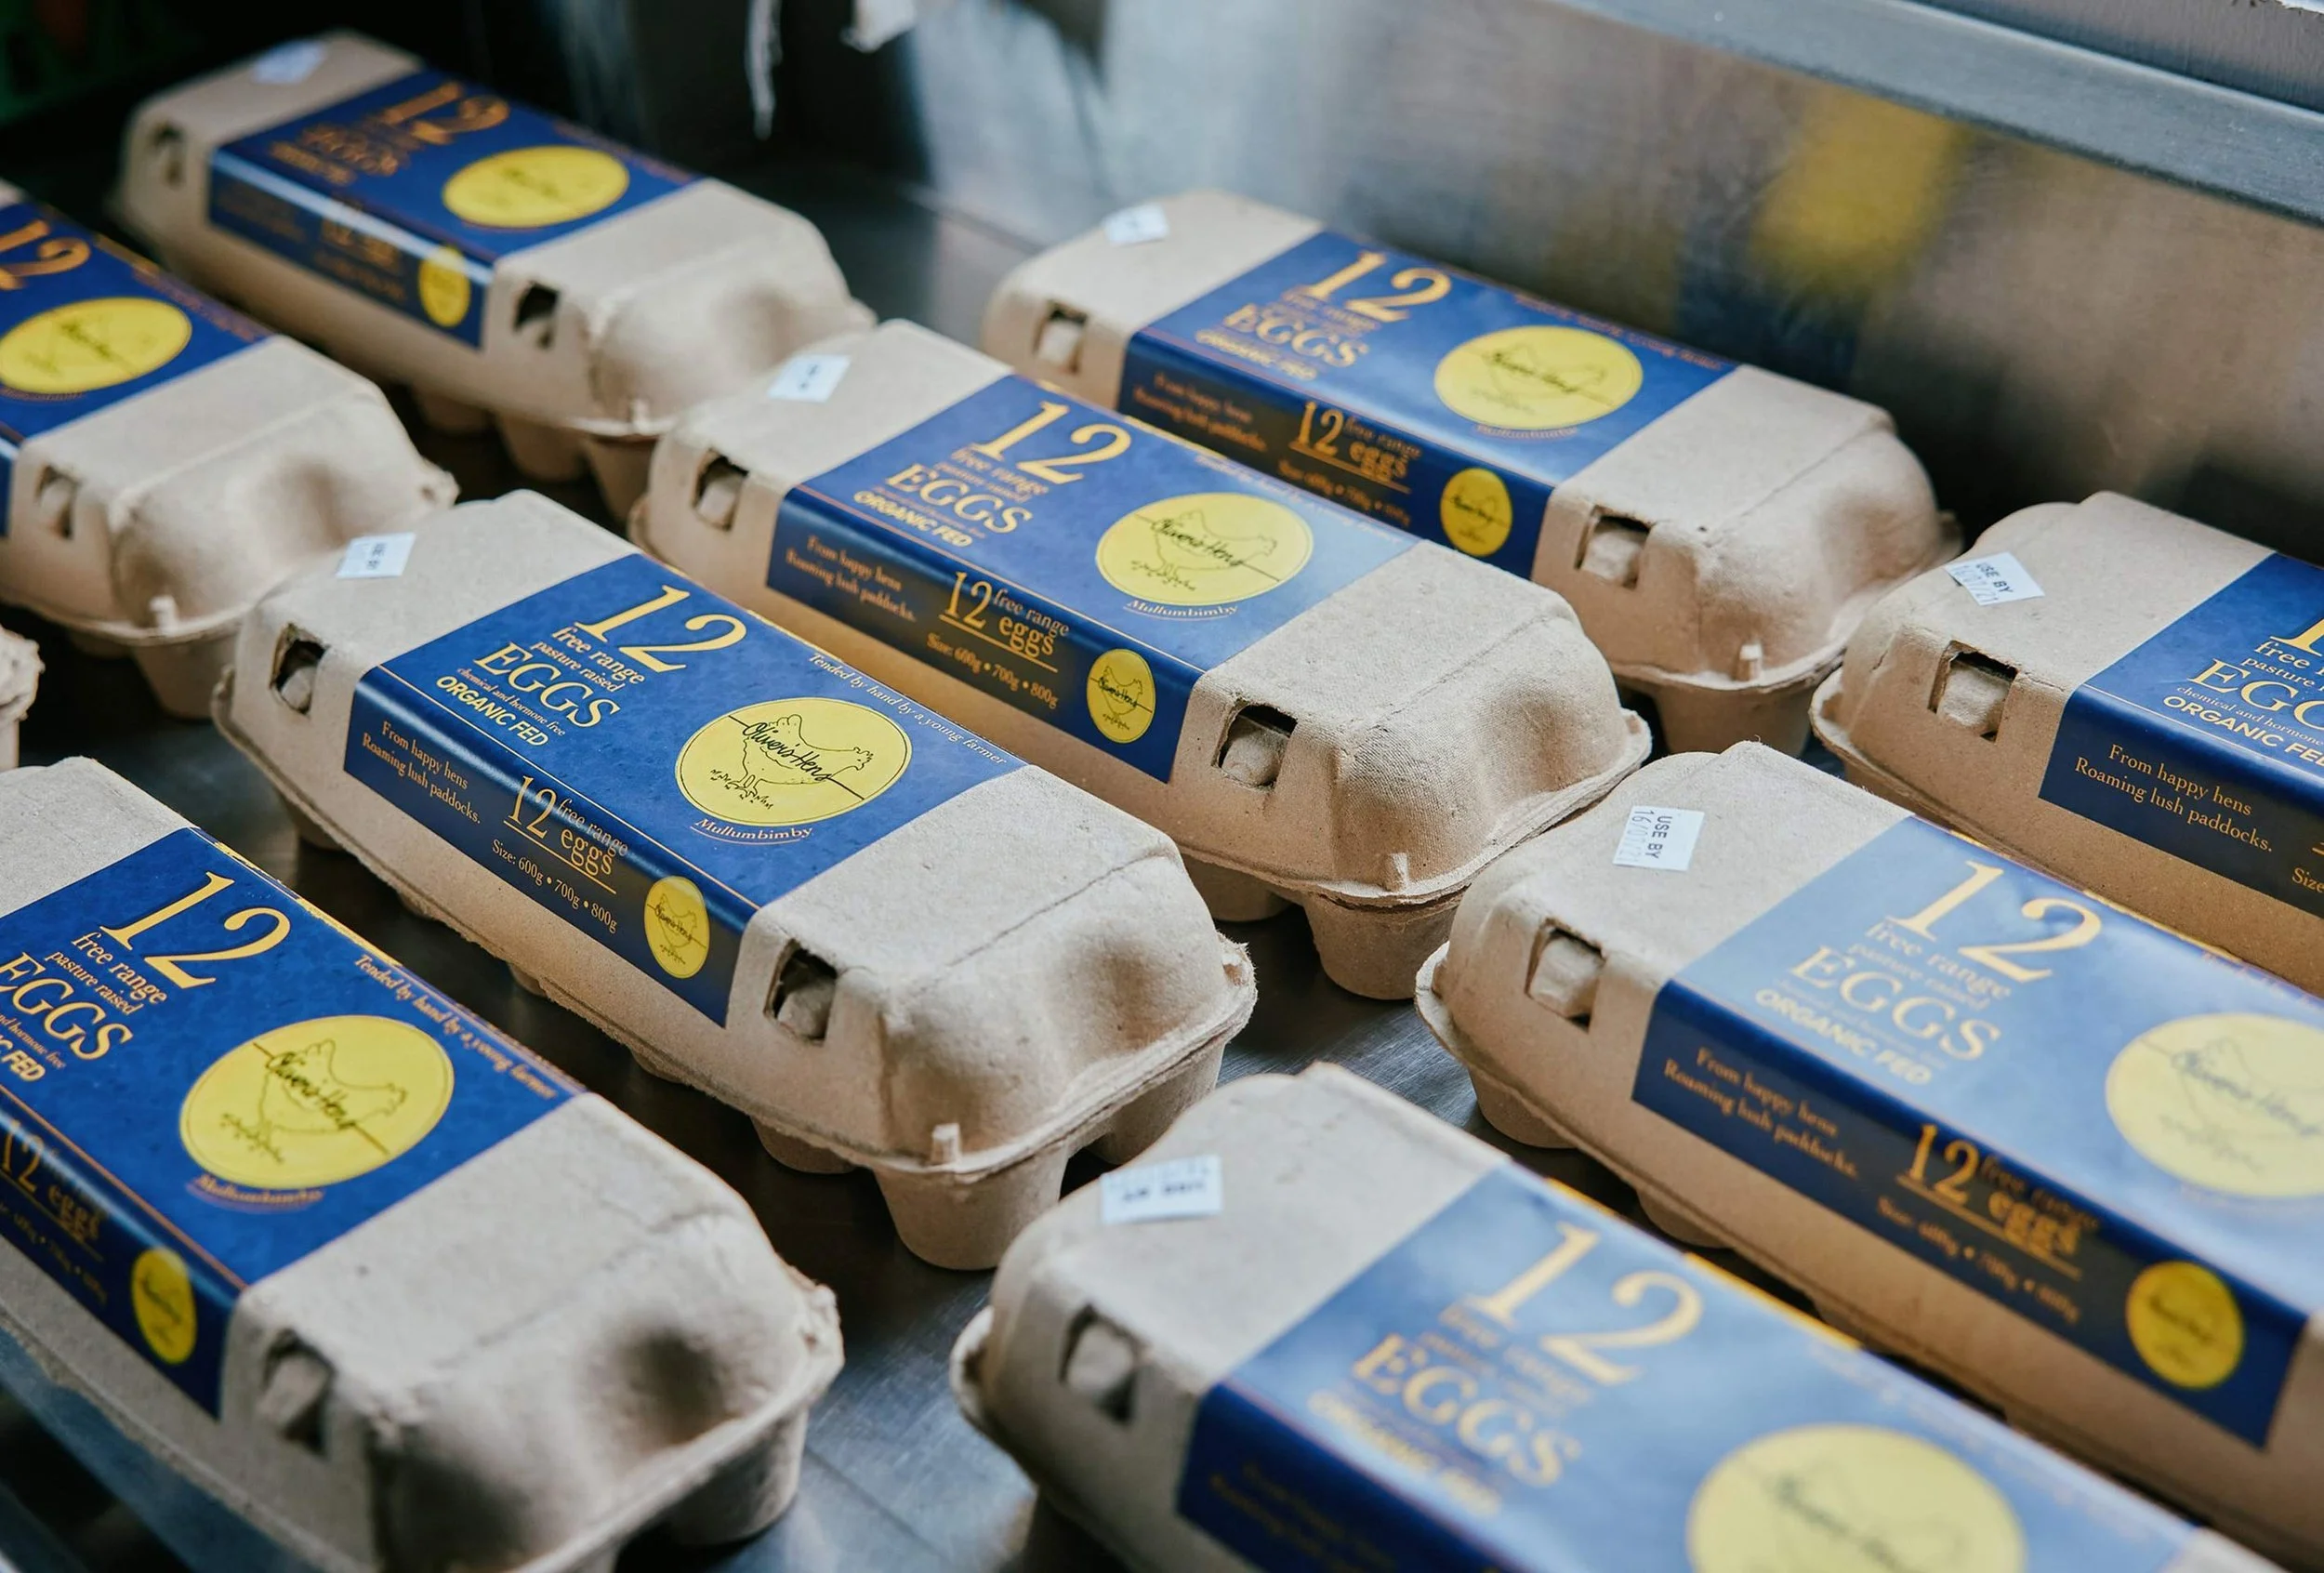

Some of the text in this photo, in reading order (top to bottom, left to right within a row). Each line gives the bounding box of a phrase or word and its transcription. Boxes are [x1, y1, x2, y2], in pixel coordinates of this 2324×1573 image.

[376, 80, 509, 144] 12
[1303, 249, 1452, 323] 12
[1222, 302, 1369, 368] EGGS
[968, 400, 1132, 486] 12
[1294, 400, 1344, 456] 12
[885, 462, 1034, 534] EGGS
[574, 584, 747, 673] 12
[943, 571, 993, 630] 12
[991, 588, 1070, 639] free range
[530, 641, 627, 693] pasture raised
[551, 626, 646, 685] free range
[998, 614, 1054, 660] eggs
[2253, 640, 2311, 669] free
[456, 667, 566, 737] chemical and hormone free
[473, 641, 622, 729] EGGS
[2176, 686, 2237, 712] chemical
[2235, 707, 2264, 723] and
[2240, 657, 2316, 688] pasture
[435, 675, 549, 747] ORGANIC FED
[808, 653, 1008, 766] Tended by hand by a young farmer
[2162, 695, 2285, 747] ORGANIC
[362, 732, 482, 825] Roaming lush paddocks.
[381, 720, 469, 790] From happy hens
[789, 749, 833, 782] Hens
[2108, 743, 2253, 816] From happy hens
[508, 773, 558, 839] 12
[557, 798, 629, 858] free range
[693, 817, 813, 840] Mullumbimby
[1644, 814, 1673, 860] USE BY
[2074, 756, 2274, 853] Roaming lush paddocks.
[492, 838, 618, 934] Size: 600g 700g 800g
[561, 826, 613, 878] eggs
[99, 870, 291, 989] 12
[1882, 860, 2103, 984] 12
[45, 951, 144, 1016] pasture raised
[71, 931, 168, 1005] free range
[354, 954, 404, 990] Tended
[395, 983, 416, 1001] by
[1864, 918, 2012, 1001] free range
[0, 951, 134, 1061] EGGS
[1754, 987, 1880, 1059] ORGANIC
[1873, 1047, 1934, 1087] FED
[1787, 944, 2003, 1062] EGGS
[1, 1049, 46, 1082] FED
[1906, 1122, 1980, 1206] 12
[1987, 1189, 2082, 1257] eggs
[1463, 1220, 1705, 1386] 12
[1351, 1332, 1582, 1487] EGGS
